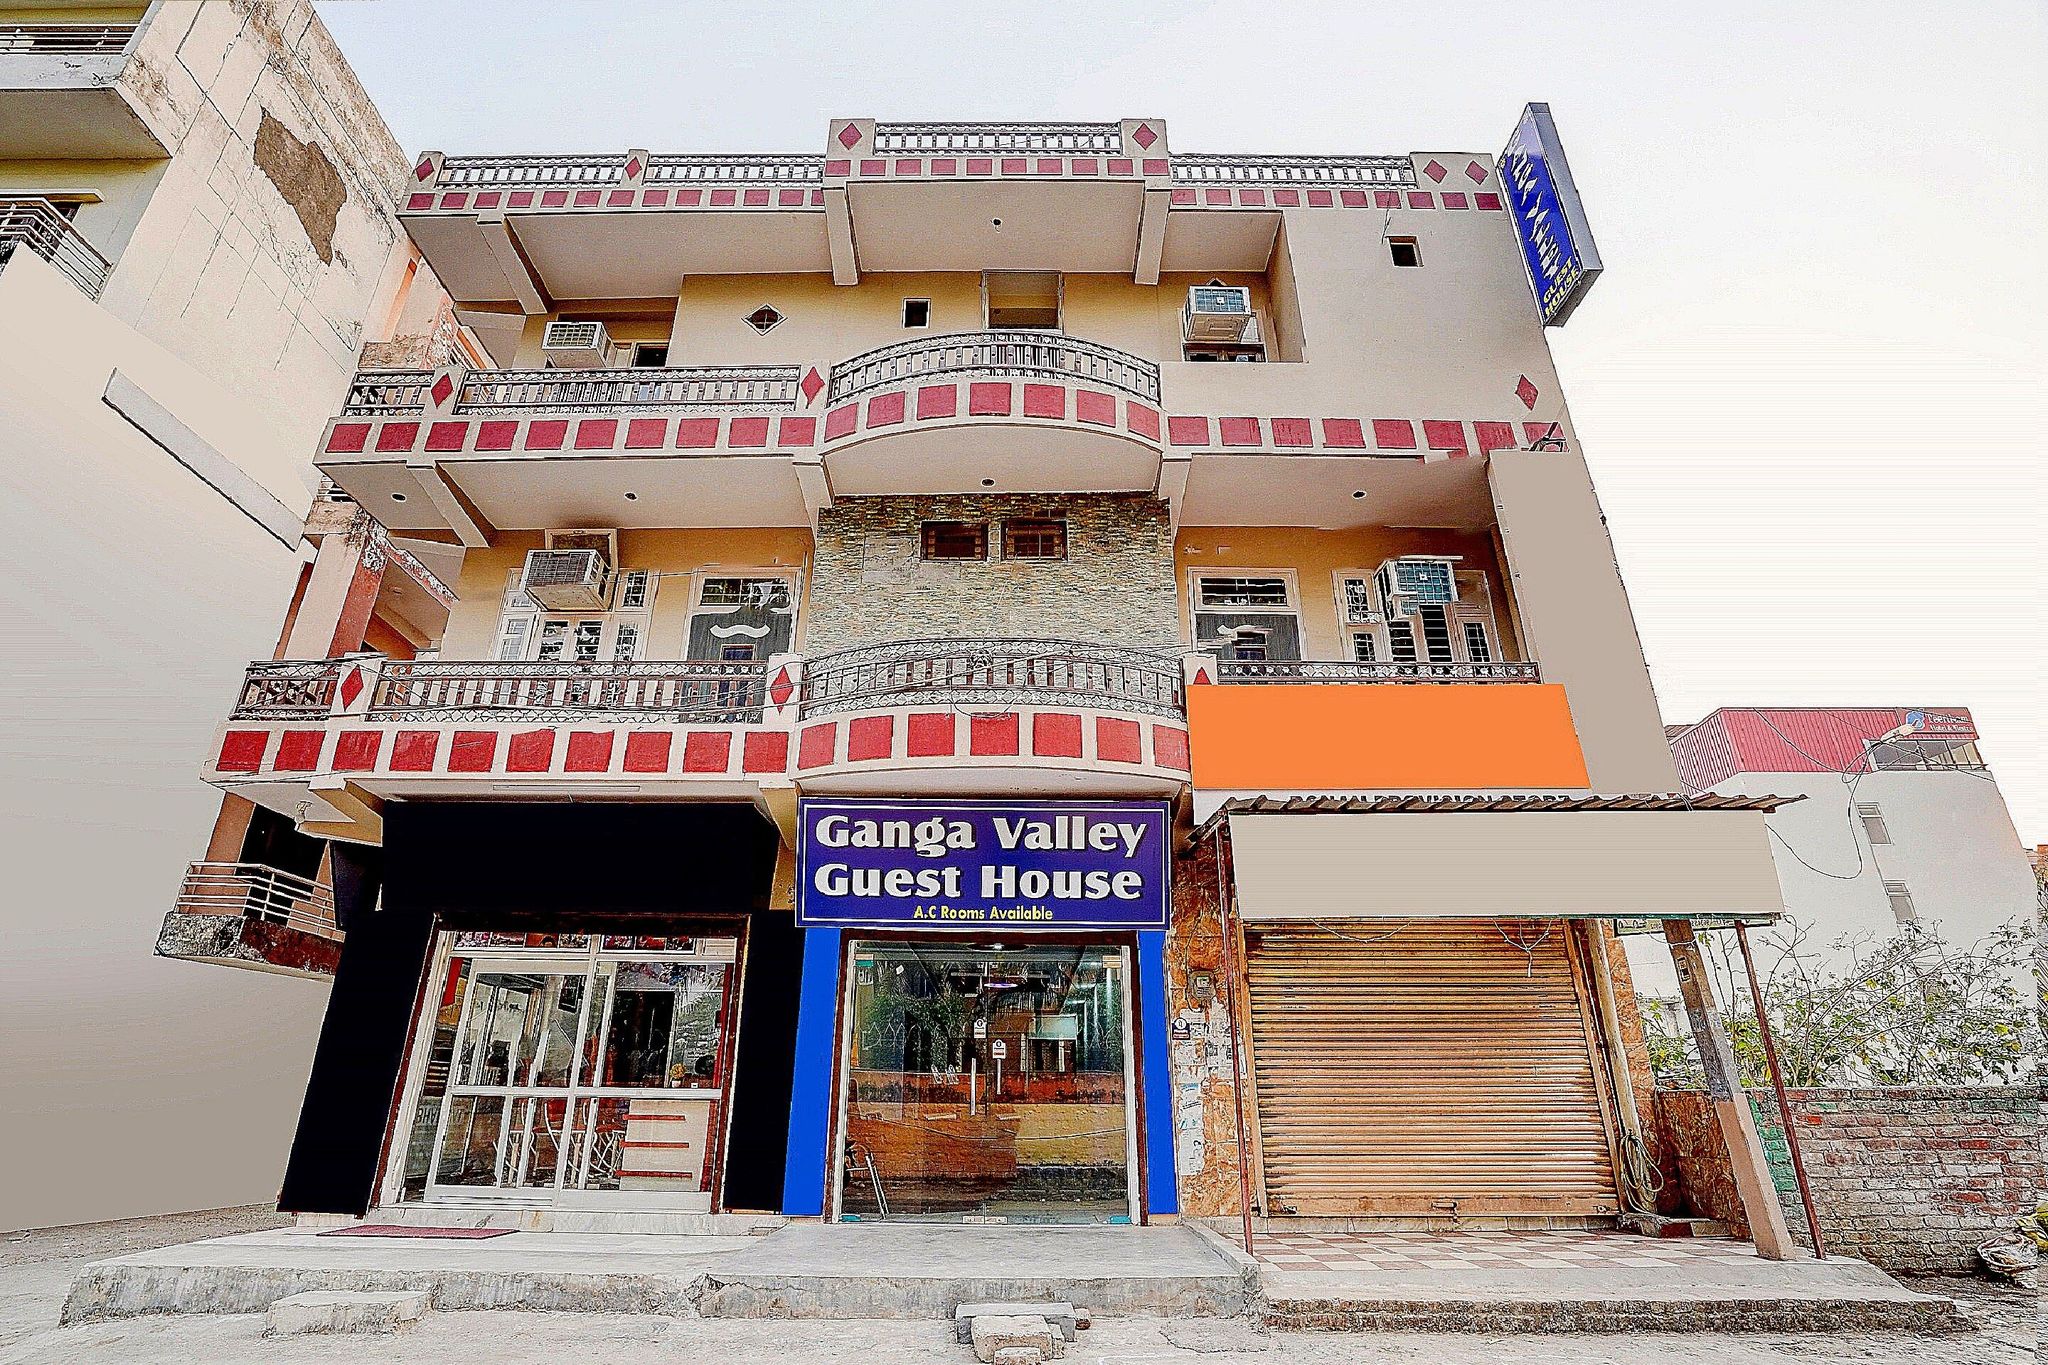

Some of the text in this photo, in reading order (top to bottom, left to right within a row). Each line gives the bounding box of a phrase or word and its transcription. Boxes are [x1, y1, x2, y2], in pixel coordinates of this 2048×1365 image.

[1543, 255, 1572, 304] GUEST
[1544, 265, 1578, 317] HOUSE
[814, 814, 1147, 859] Ganga Valley
[813, 863, 1143, 900] Guest House
[913, 904, 1054, 920] A.C Rooms Available
